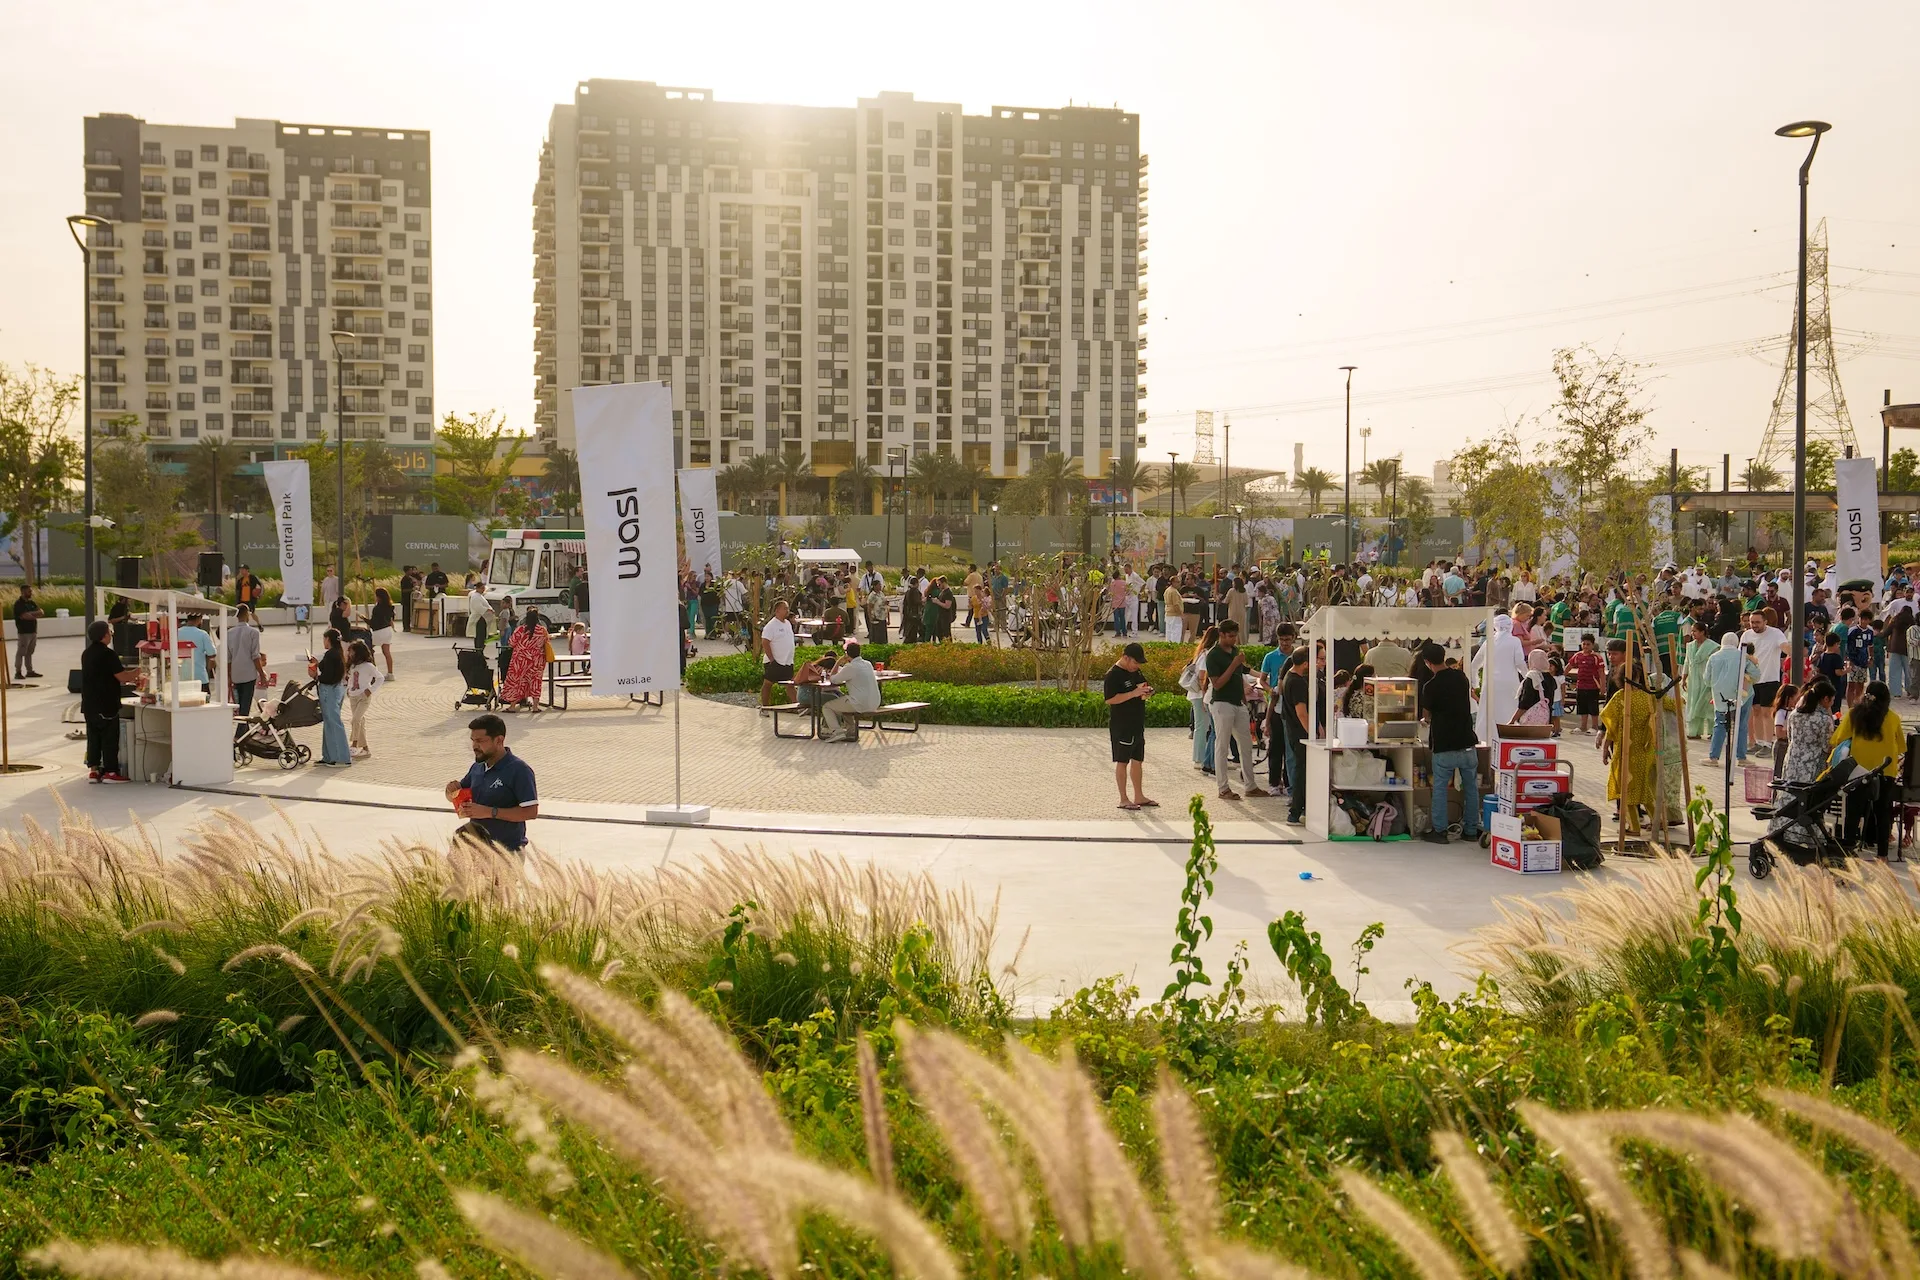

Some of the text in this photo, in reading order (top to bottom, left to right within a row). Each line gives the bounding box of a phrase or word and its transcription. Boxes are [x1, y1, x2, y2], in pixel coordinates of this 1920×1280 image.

[282, 492, 294, 567] Central Park
[690, 507, 706, 543] wasl
[1847, 508, 1862, 552] wasl
[607, 486, 642, 580] wasl
[405, 542, 460, 550] CENTRAL PARK
[861, 540, 882, 548] وصل
[989, 540, 1006, 548] مكن
[1855, 638, 1864, 648] 10
[617, 676, 652, 685] wasl.ae
